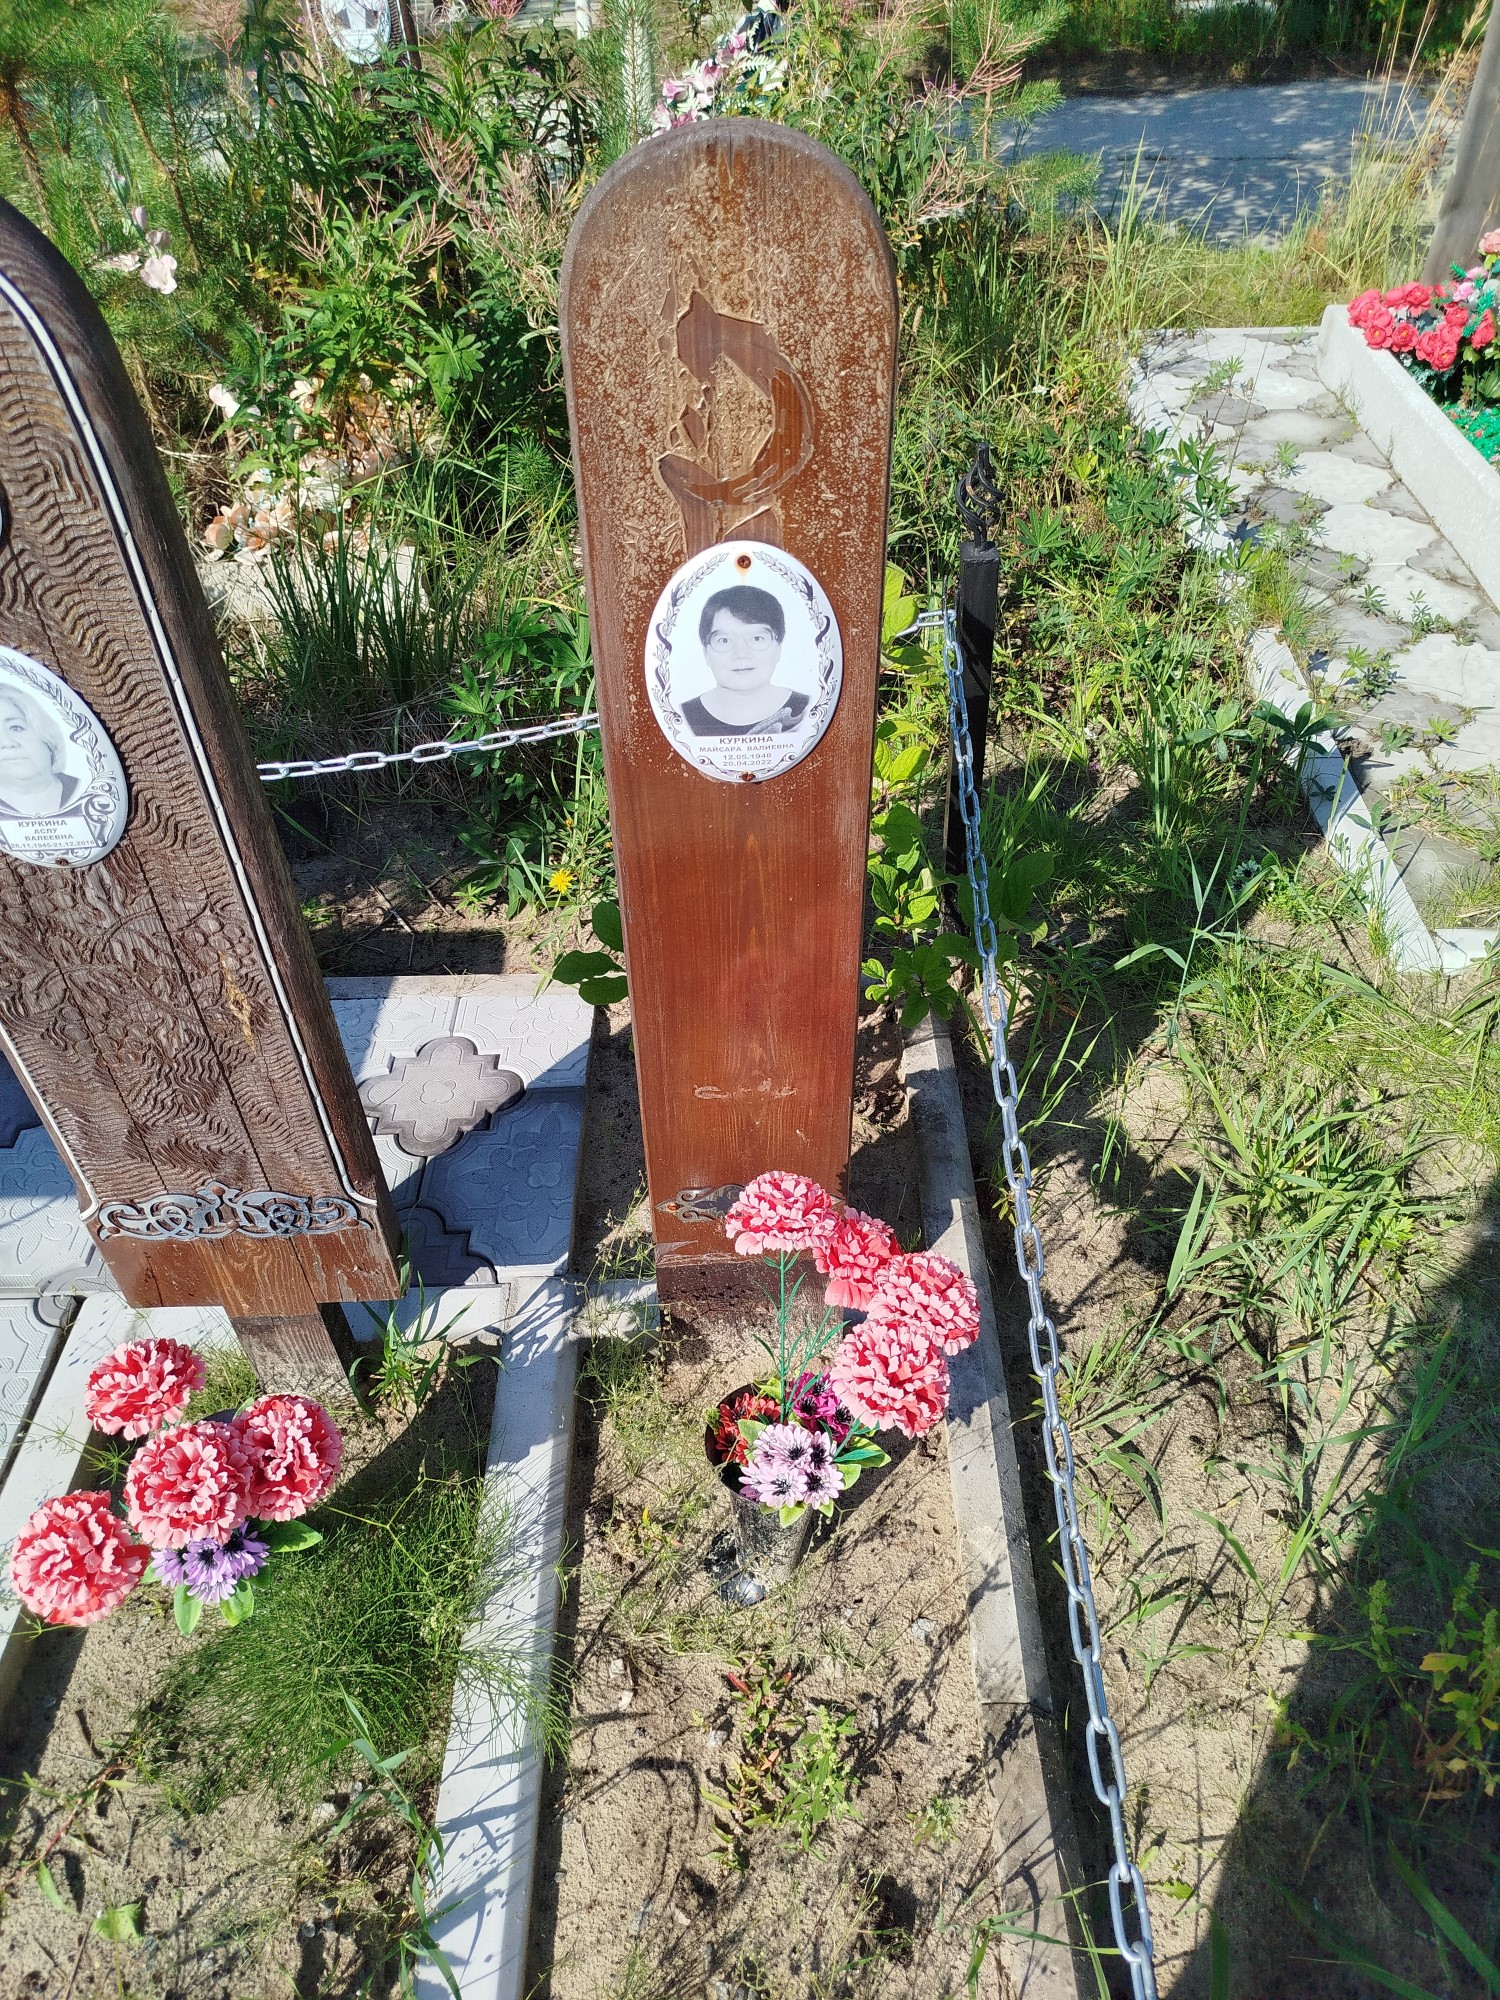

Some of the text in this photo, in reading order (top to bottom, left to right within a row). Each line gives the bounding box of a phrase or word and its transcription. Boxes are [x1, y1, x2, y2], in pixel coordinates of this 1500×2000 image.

[719, 736, 774, 744] КУРКИНА
[747, 743, 794, 751] ВАЛИЕВНА
[722, 759, 772, 767] 20.04.2022
[17, 819, 68, 828] КУРКИНА
